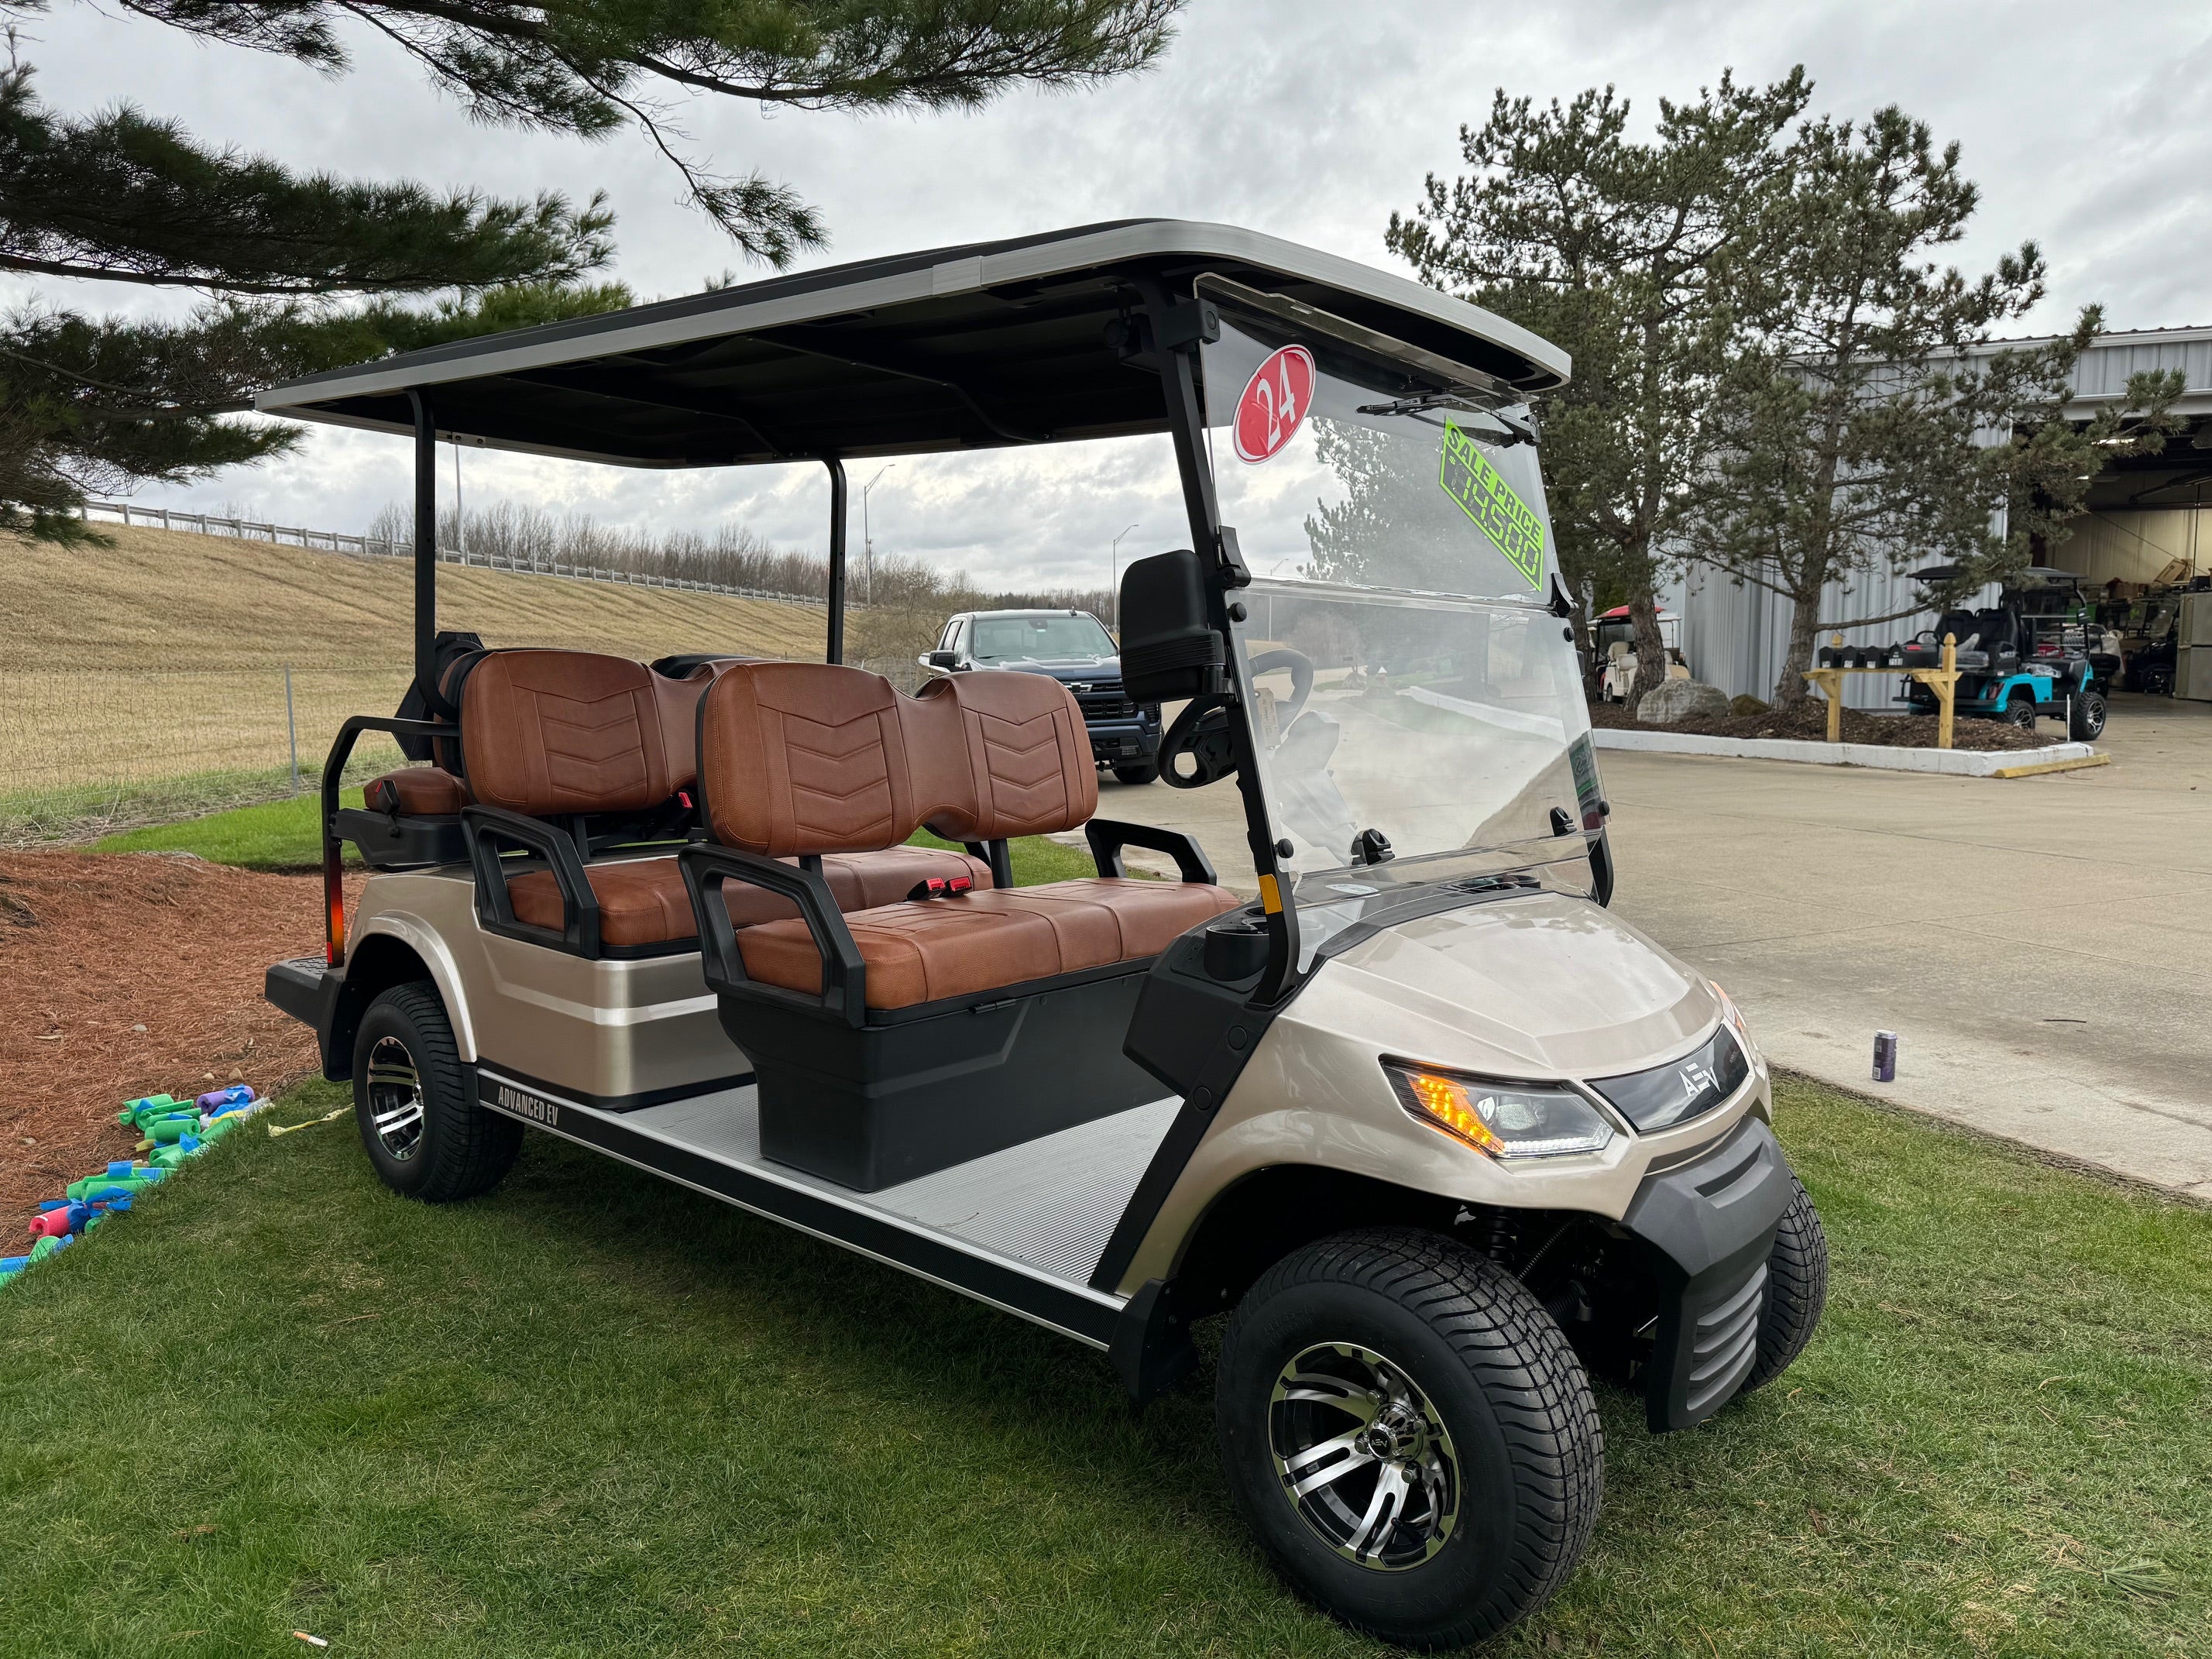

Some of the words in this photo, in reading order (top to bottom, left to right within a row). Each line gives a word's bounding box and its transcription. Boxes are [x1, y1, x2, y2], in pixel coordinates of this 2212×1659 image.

[1256, 353, 1296, 453] 24
[1448, 428, 1492, 486] SALE
[1493, 479, 1541, 544] PRICE
[1678, 1062, 1721, 1097] AEV
[498, 1086, 544, 1121] ADVANCED
[546, 1104, 558, 1126] EV
[1371, 1438, 1388, 1448] AEV
